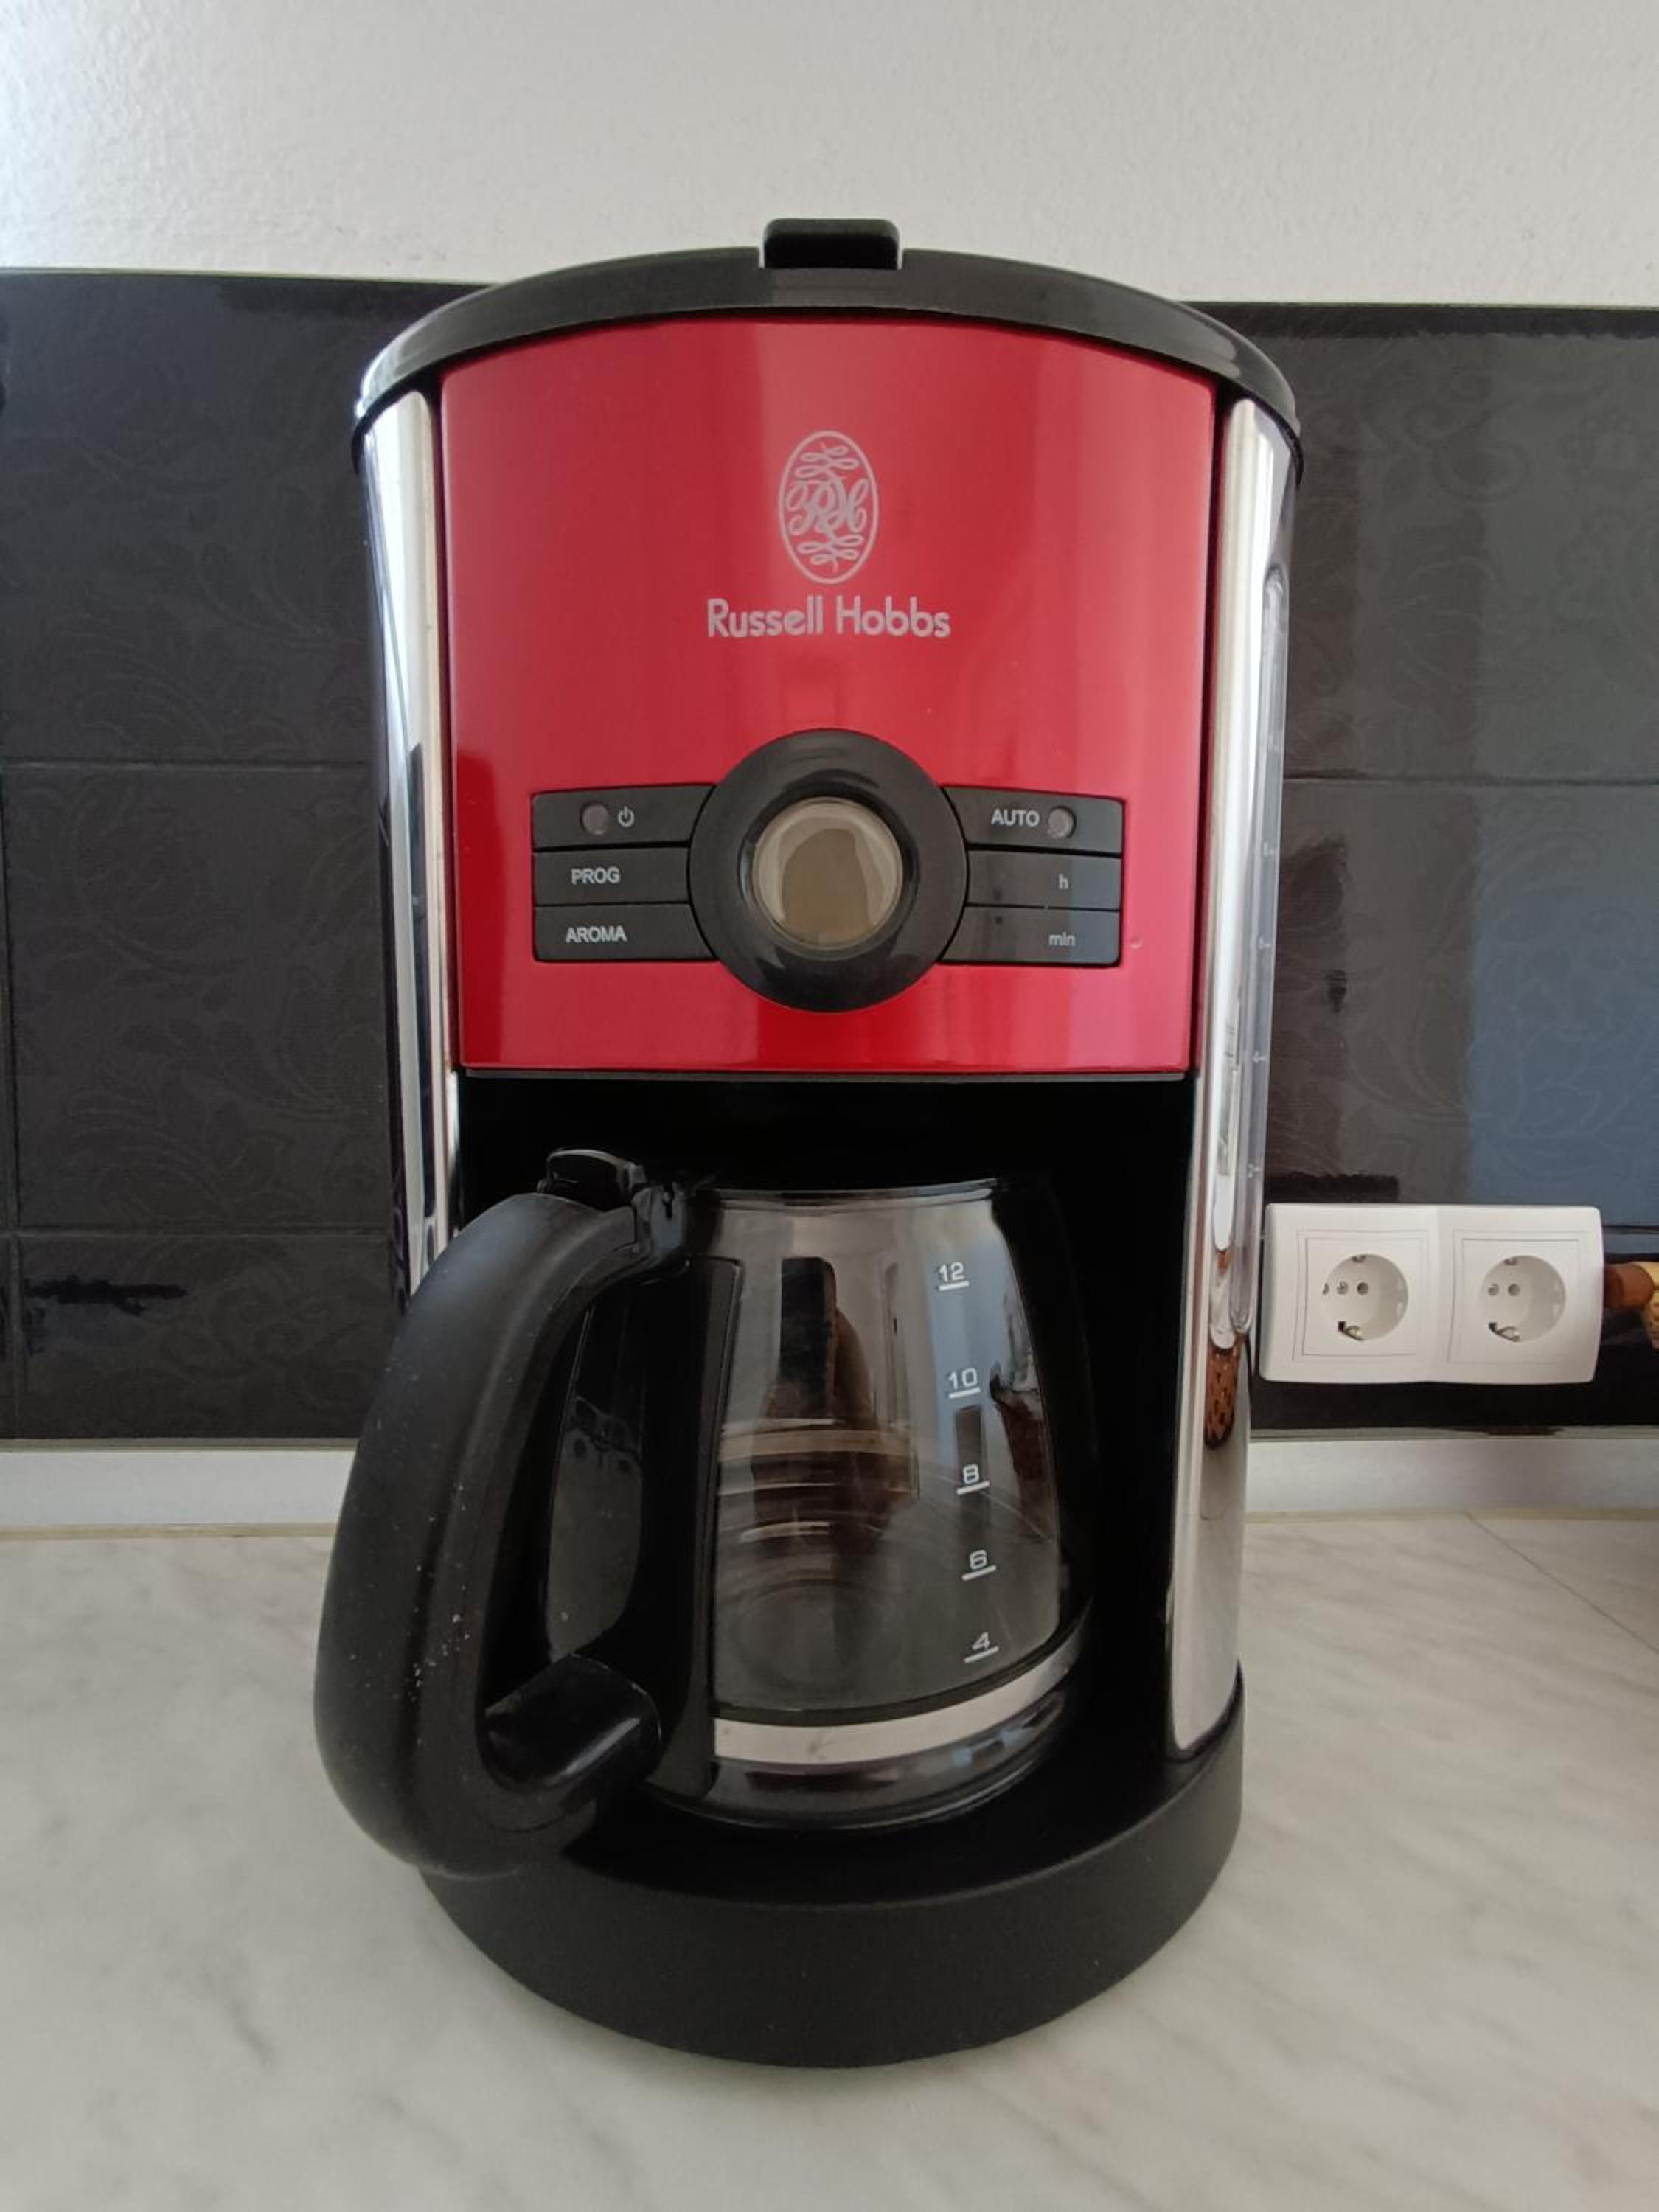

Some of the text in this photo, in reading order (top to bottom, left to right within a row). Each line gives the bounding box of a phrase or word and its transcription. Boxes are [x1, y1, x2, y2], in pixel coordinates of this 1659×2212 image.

[706, 595, 951, 638] Russell Hobbs
[990, 808, 1040, 828] AUTO
[571, 867, 621, 885] PROG
[1058, 874, 1069, 890] h
[566, 925, 627, 944] AROMA
[1048, 931, 1076, 947] min
[939, 1262, 965, 1282] 12
[948, 1368, 978, 1389] 10
[963, 1464, 980, 1484] 8
[970, 1550, 987, 1570] 6
[972, 1632, 990, 1650] 4
